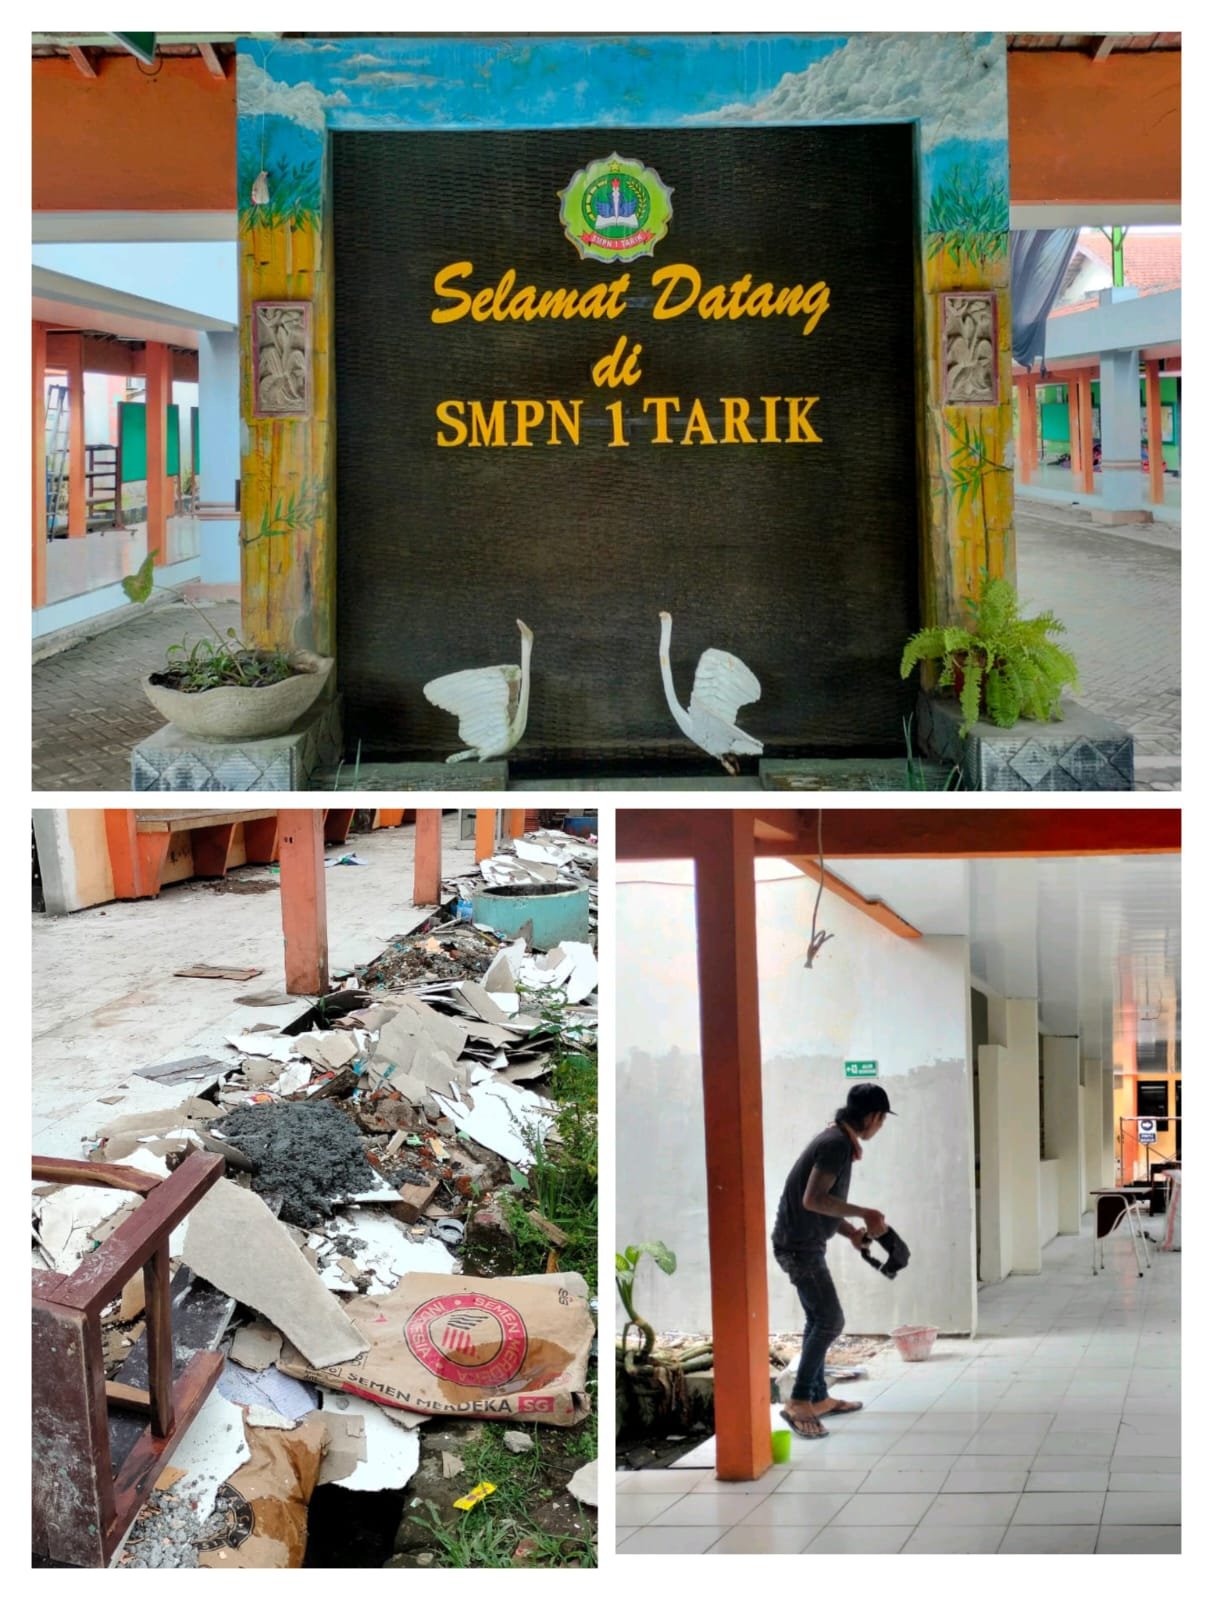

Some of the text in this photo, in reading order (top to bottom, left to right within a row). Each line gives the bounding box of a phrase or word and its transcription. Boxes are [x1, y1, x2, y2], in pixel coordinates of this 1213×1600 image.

[592, 234, 612, 248] SMPN
[621, 232, 643, 248] TARIK
[431, 261, 831, 336] Selamat Datang
[592, 335, 643, 388] di
[436, 396, 823, 447] SMPN 1 TARIK
[410, 1301, 446, 1359] INDESIA
[473, 1297, 521, 1334] SEMEN
[347, 1372, 411, 1402] SEMEN
[523, 1400, 549, 1413] SG
